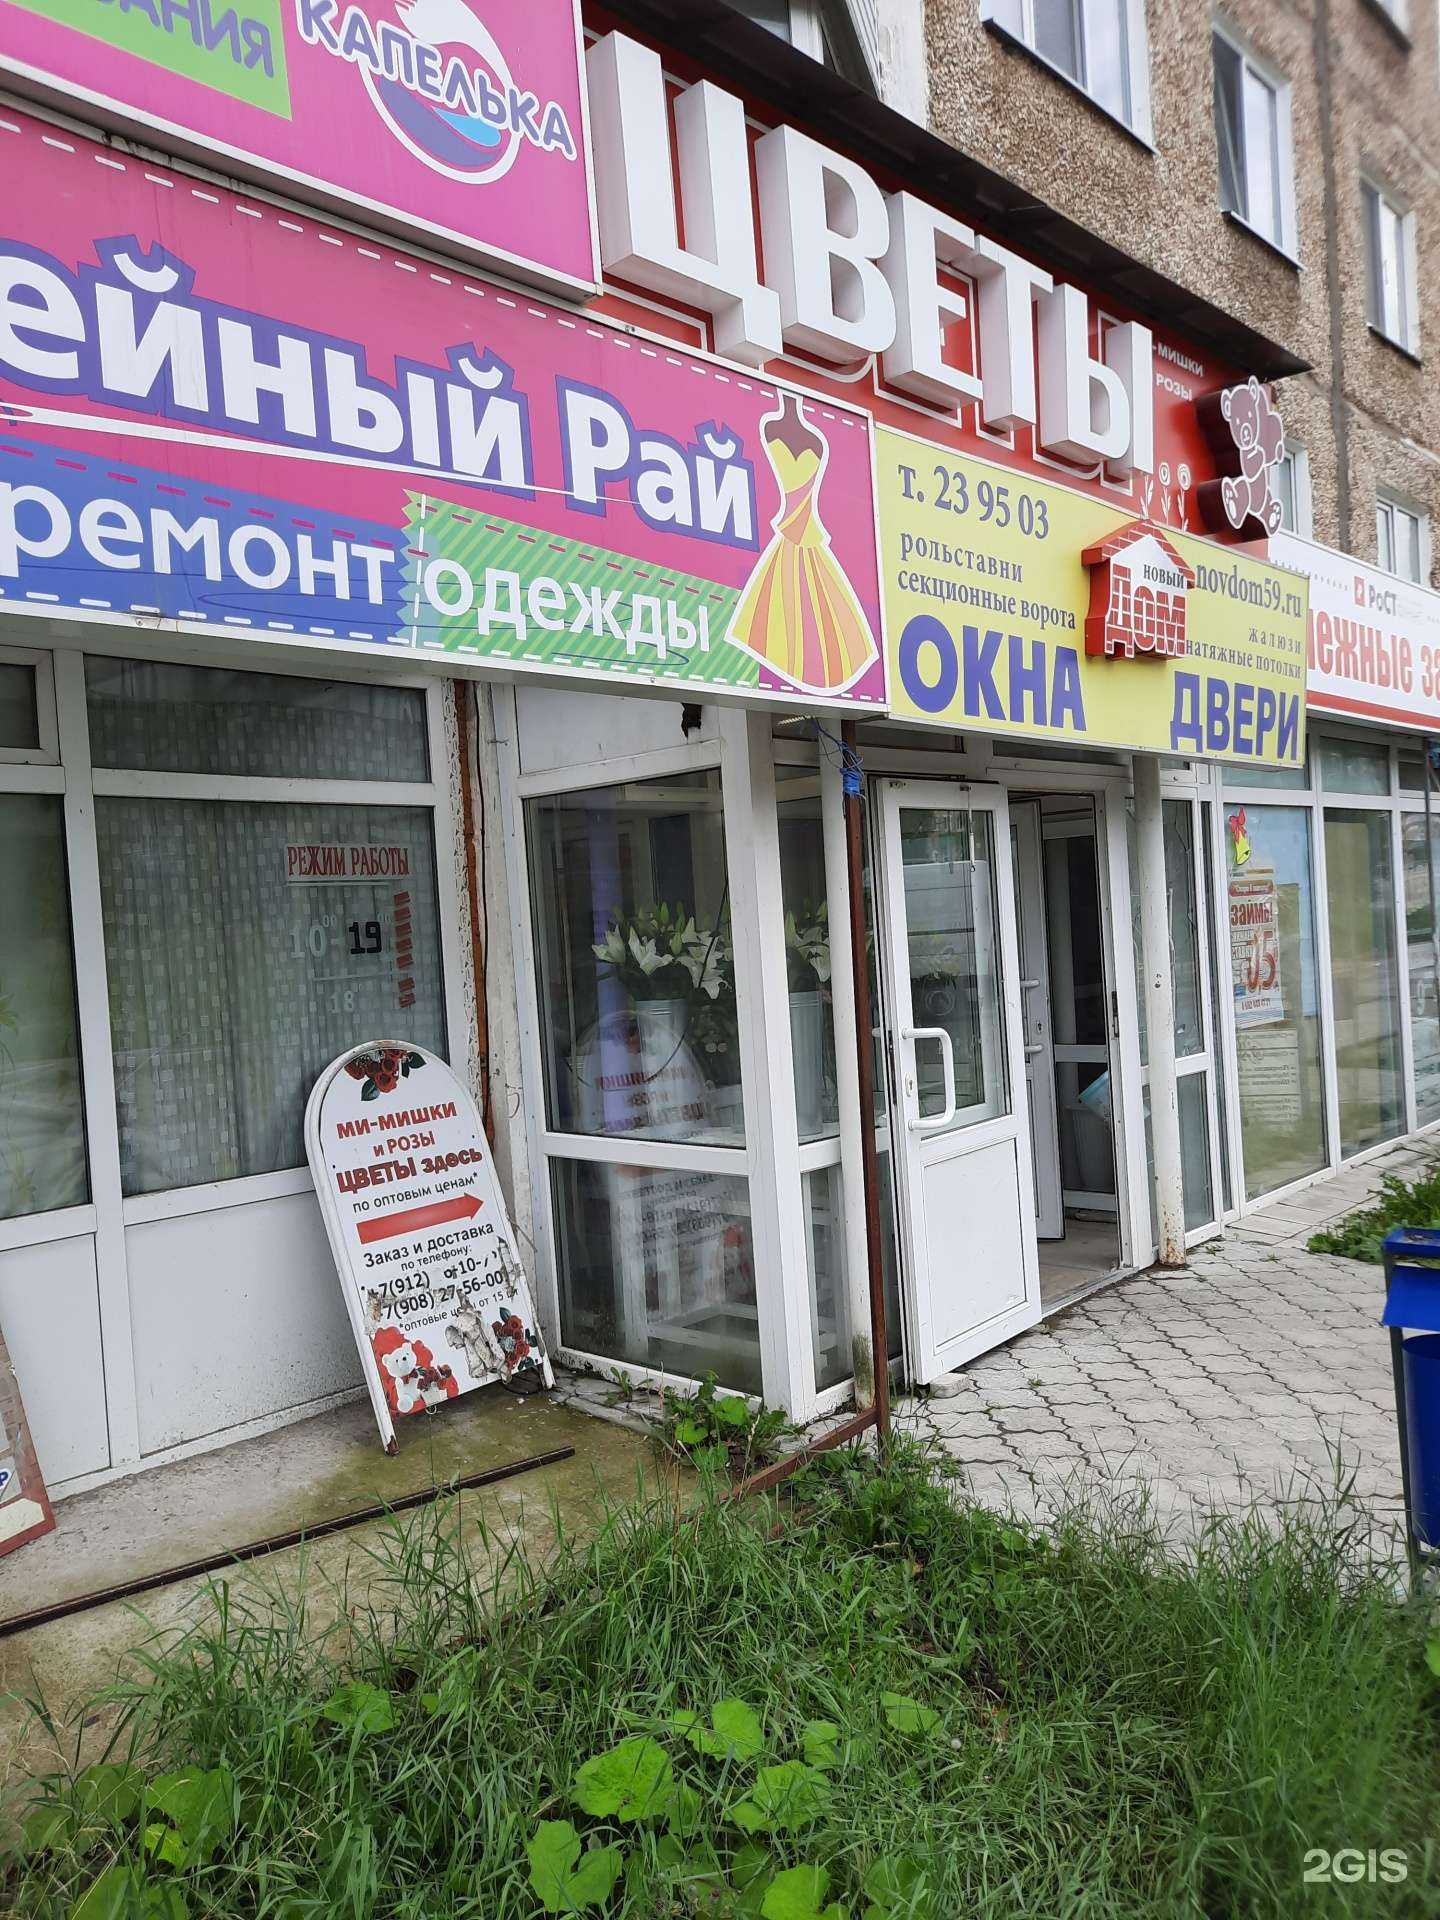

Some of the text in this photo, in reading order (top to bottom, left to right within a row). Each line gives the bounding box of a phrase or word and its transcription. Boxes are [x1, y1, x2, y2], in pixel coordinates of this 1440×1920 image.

[300, 0, 575, 156] КАПЕЛЬКА
[586, 30, 1153, 474] ЦВЕТЫ
[1156, 373, 1192, 401] РОЗЫ
[564, 391, 753, 541] Рай
[934, 466, 969, 515] 23
[977, 480, 1011, 527] 95
[1018, 494, 1049, 539] 03
[0, 480, 710, 658] ремонт одежды
[900, 532, 1023, 583] рольставни
[898, 569, 1076, 630] секционные ворота
[1104, 562, 1186, 658] ДОМ
[1196, 564, 1302, 618] novdom59.ru
[1186, 639, 1301, 679] натяжные потолки
[1248, 627, 1301, 655] жалюзи
[899, 613, 1087, 732] ОКНА
[1170, 671, 1300, 761] ДВЕРИ
[287, 845, 411, 876] РЕЖИМ РАБОТЫ
[349, 921, 383, 955] 19
[336, 1101, 458, 1139] МИ-МИШКИ
[373, 1131, 436, 1157] и РОЗЫ
[336, 1157, 418, 1194] ЦВЕТЫ
[353, 1201, 370, 1213] по
[374, 1187, 432, 1209] оптовым
[363, 1222, 494, 1268] Заказ и доставка
[401, 1244, 472, 1272] по телефону:
[380, 1291, 434, 1320] 7(908)
[479, 1297, 489, 1308] от
